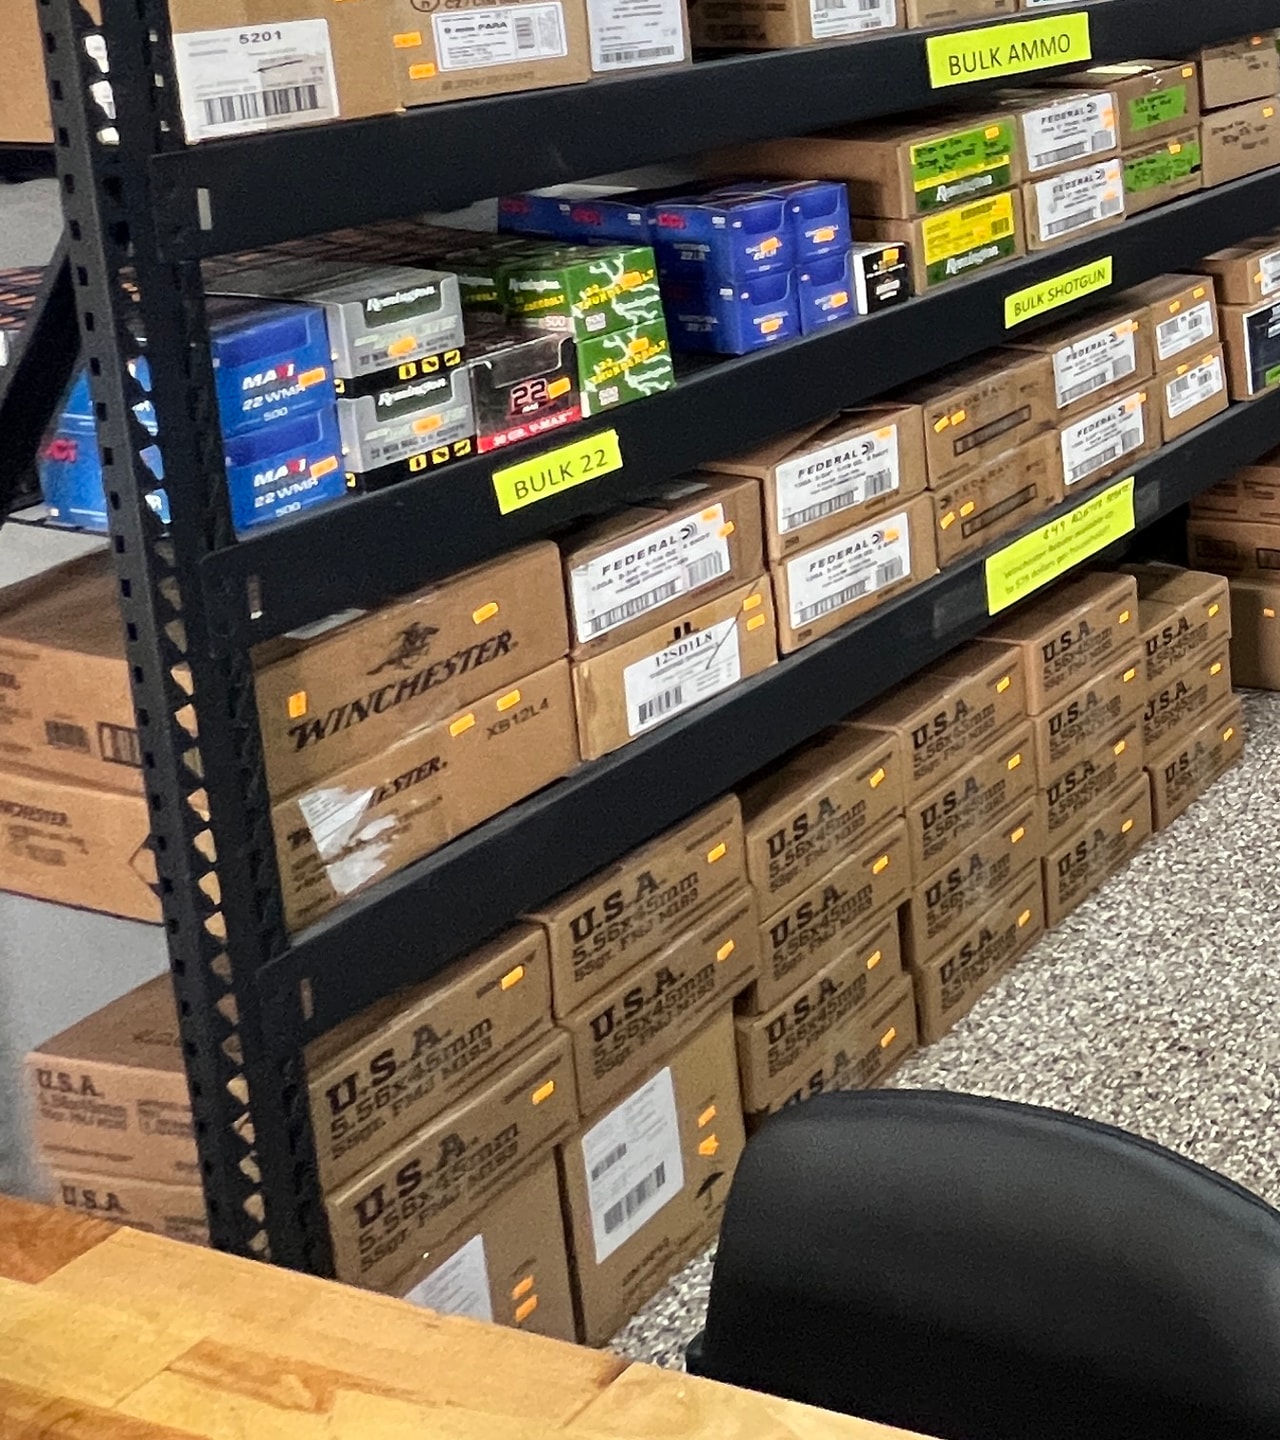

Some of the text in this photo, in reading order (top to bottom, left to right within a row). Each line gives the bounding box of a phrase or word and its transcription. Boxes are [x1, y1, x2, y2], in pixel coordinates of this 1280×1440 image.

[239, 29, 283, 46] 5201
[948, 33, 1071, 76] BULK AMMO
[1041, 109, 1084, 125] FEDERAL
[936, 175, 993, 202] Remington
[946, 245, 999, 275] Remington
[367, 287, 435, 312] Remington
[1013, 267, 1107, 317] BULK SHOTGUN
[1066, 340, 1107, 362] FEDERAL
[242, 396, 264, 411] 22
[378, 377, 447, 406] Remington
[512, 381, 548, 405] 22
[264, 407, 288, 422] 500
[514, 449, 607, 499] BULK 22
[798, 450, 858, 478] FEDERAL
[254, 492, 276, 507] 22
[276, 501, 302, 518] 500
[602, 536, 677, 576] FEDERAL
[809, 540, 869, 572] FEDERAL
[287, 630, 517, 751] WINCHESTER
[487, 698, 550, 740] XB12L4
[912, 699, 974, 750] U.S.A.
[766, 796, 842, 859] U.S.A.
[569, 870, 667, 944] U.S.A.
[770, 885, 847, 948] U.S.A.
[590, 966, 684, 1042] U.S.A.
[325, 1023, 452, 1116] U.S.A.
[354, 1132, 479, 1228] U.S.A.
